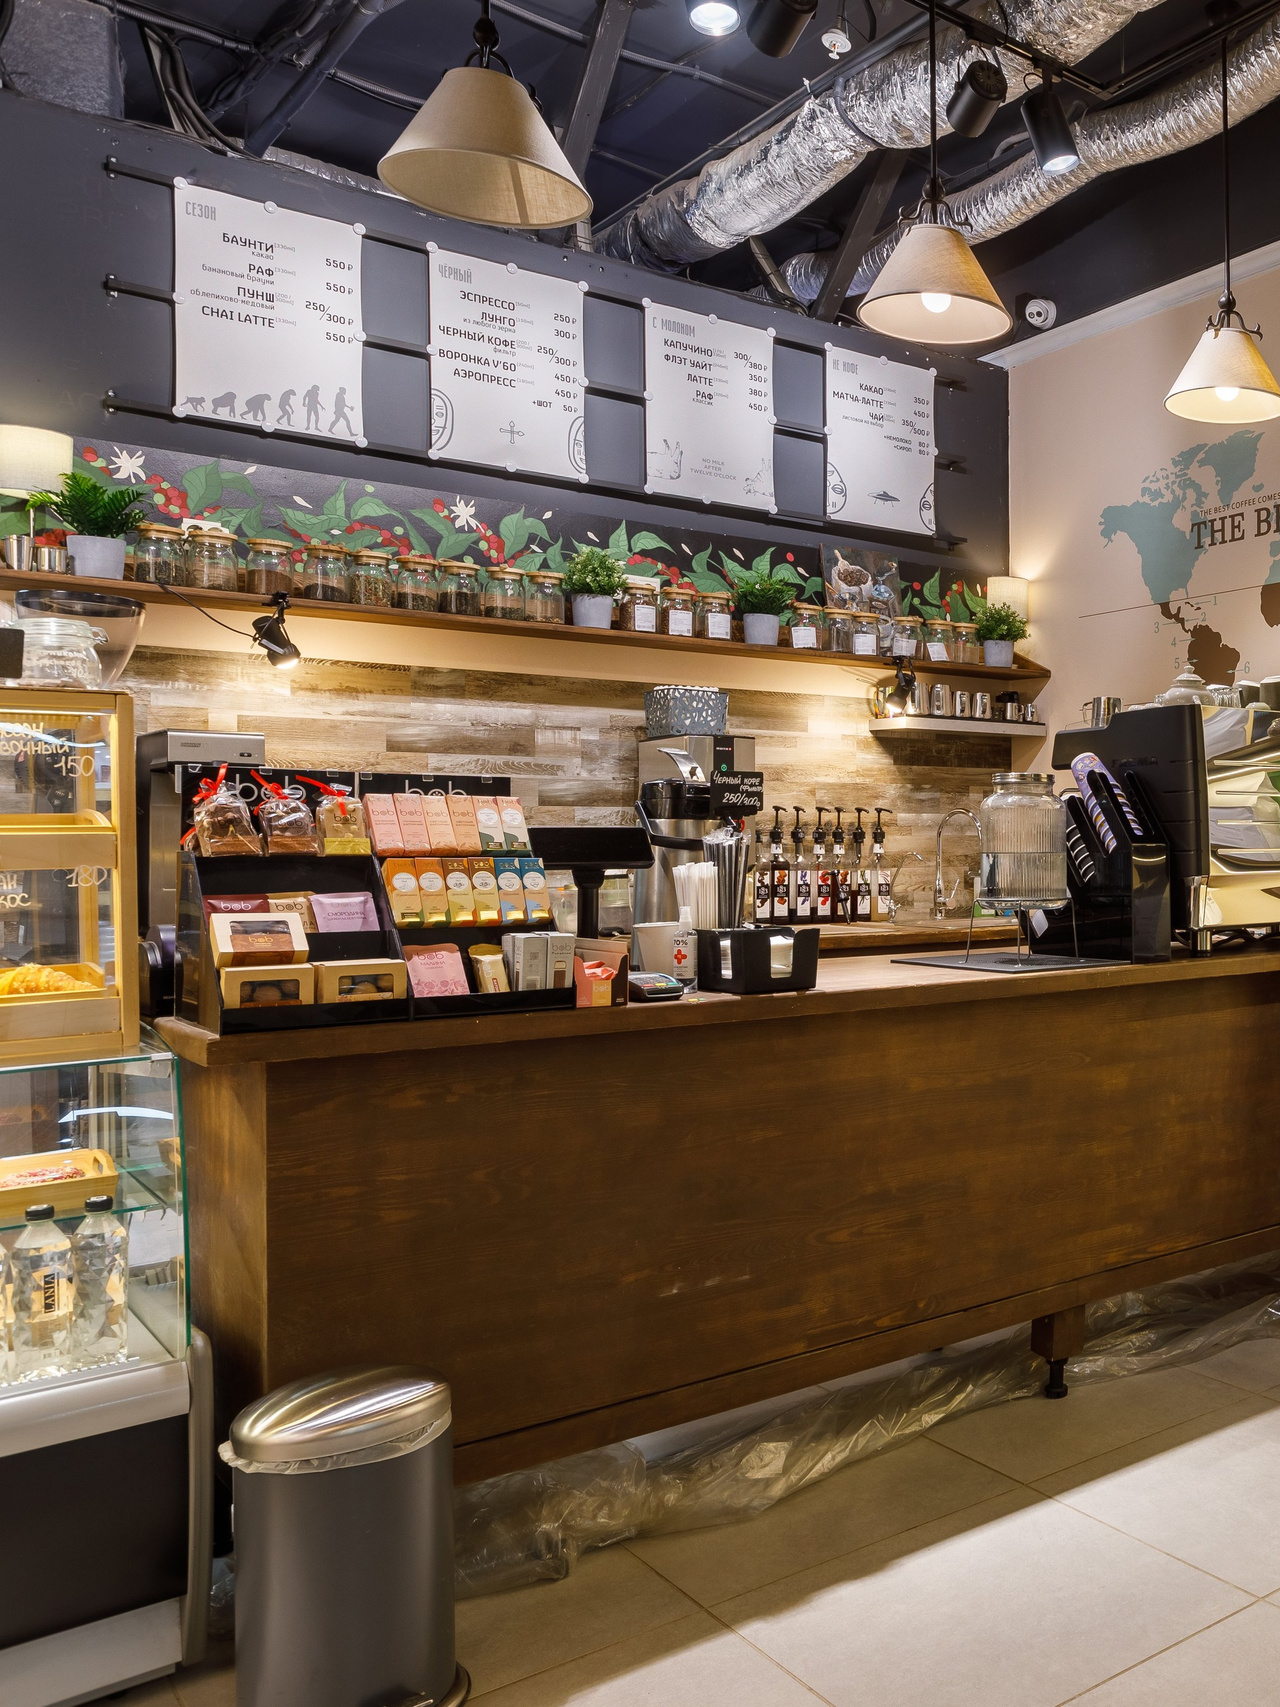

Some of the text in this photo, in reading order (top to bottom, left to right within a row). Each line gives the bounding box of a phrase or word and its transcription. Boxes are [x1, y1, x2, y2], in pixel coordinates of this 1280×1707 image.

[186, 201, 216, 221] СЕЗОН
[223, 232, 274, 253] БАУНТИ
[252, 251, 274, 260] какао
[202, 264, 274, 285] банановый брауни
[249, 263, 274, 277] РАФ
[238, 287, 274, 303] ПУНШ
[460, 291, 515, 311] ЭСПРЕССО
[202, 305, 275, 328] CHAI LATTE
[481, 312, 516, 327] ЛУНГО
[661, 318, 695, 337] МОЛОКОМ
[439, 325, 485, 343] ЧЕРНЫЙ
[488, 335, 516, 349] КОФЕ
[664, 338, 713, 357] КАПУЧИНО
[439, 349, 490, 366] ВОРОНКА
[664, 354, 713, 371] ФЛЭТ УАЙТ
[454, 368, 516, 388] АЭРОПРЕСС
[687, 373, 713, 386] ЛАТТЕ
[696, 390, 713, 400] РАФ
[860, 383, 883, 395] КАКАО
[833, 390, 883, 409] МАТЧА-ЛАТТЕ
[869, 412, 884, 422] ЧАЙ
[1214, 505, 1230, 515] BEST
[1231, 498, 1256, 510] COFFEE
[1258, 493, 1280, 504] COMES
[1191, 512, 1245, 550] THE
[1213, 596, 1217, 605] 1
[1201, 612, 1206, 622] 2
[1154, 622, 1159, 633] 3
[1171, 637, 1176, 648] 4
[1174, 657, 1180, 669] 5
[1244, 661, 1250, 674] 6
[54, 754, 95, 777] 150
[1111, 756, 1157, 768] FAEMA
[44, 1274, 56, 1313] LANIA
